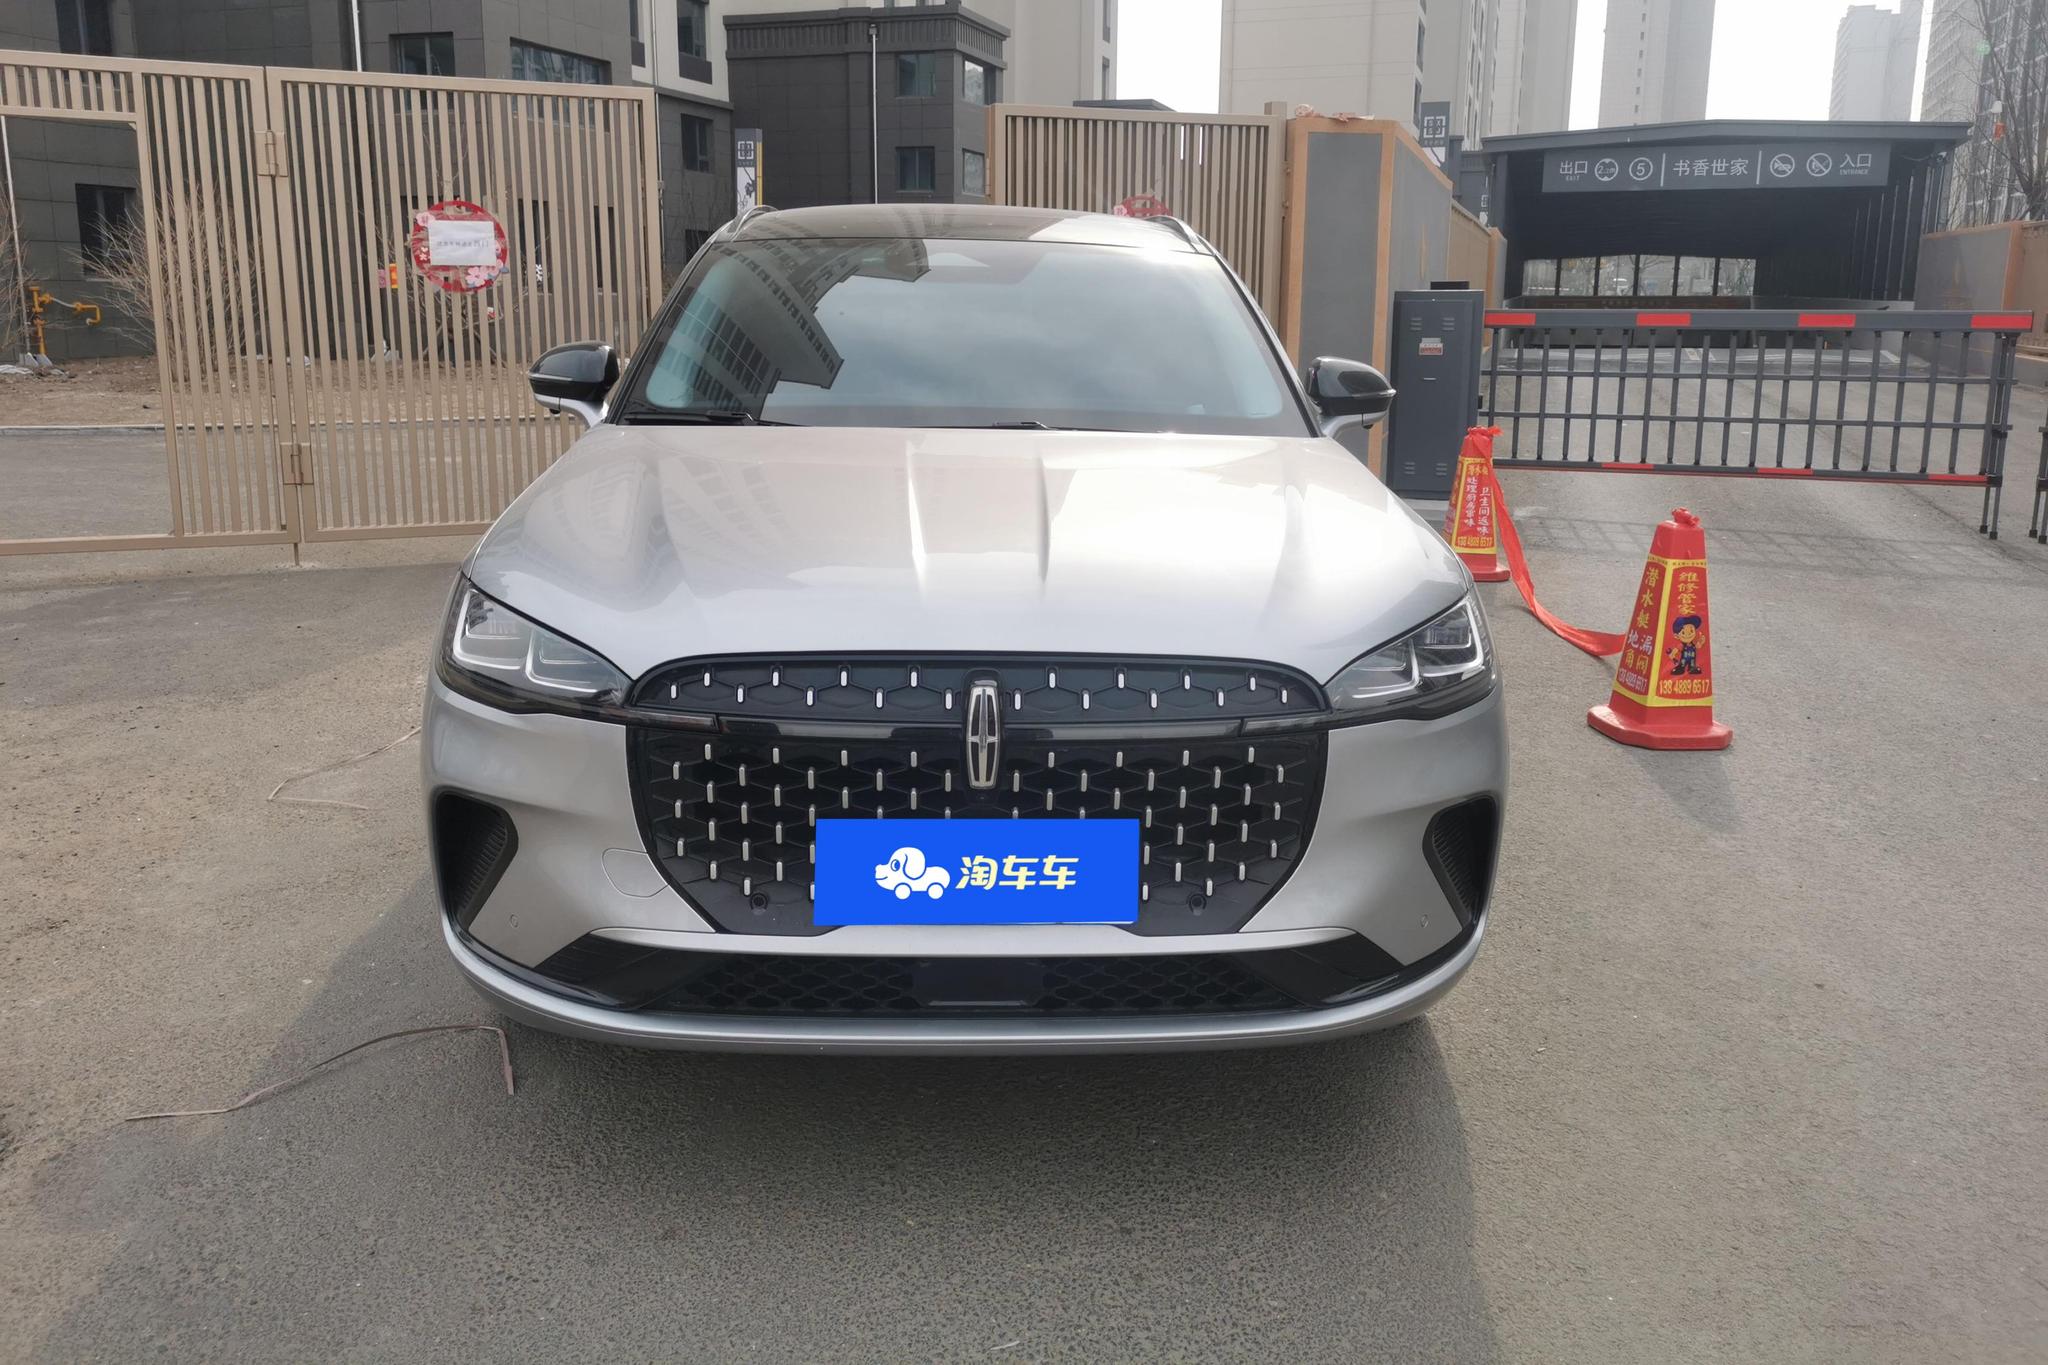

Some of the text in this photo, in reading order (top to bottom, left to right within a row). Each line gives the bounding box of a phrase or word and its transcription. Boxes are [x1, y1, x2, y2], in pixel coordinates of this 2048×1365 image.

[1560, 161, 1588, 174] 出口
[1672, 158, 1749, 176] 书香世家
[1840, 153, 1872, 168] 入口
[1636, 163, 1646, 176] 5
[1637, 567, 1659, 628] 潜水艇
[1678, 572, 1699, 614] 维修管家
[1659, 680, 1673, 694] 138
